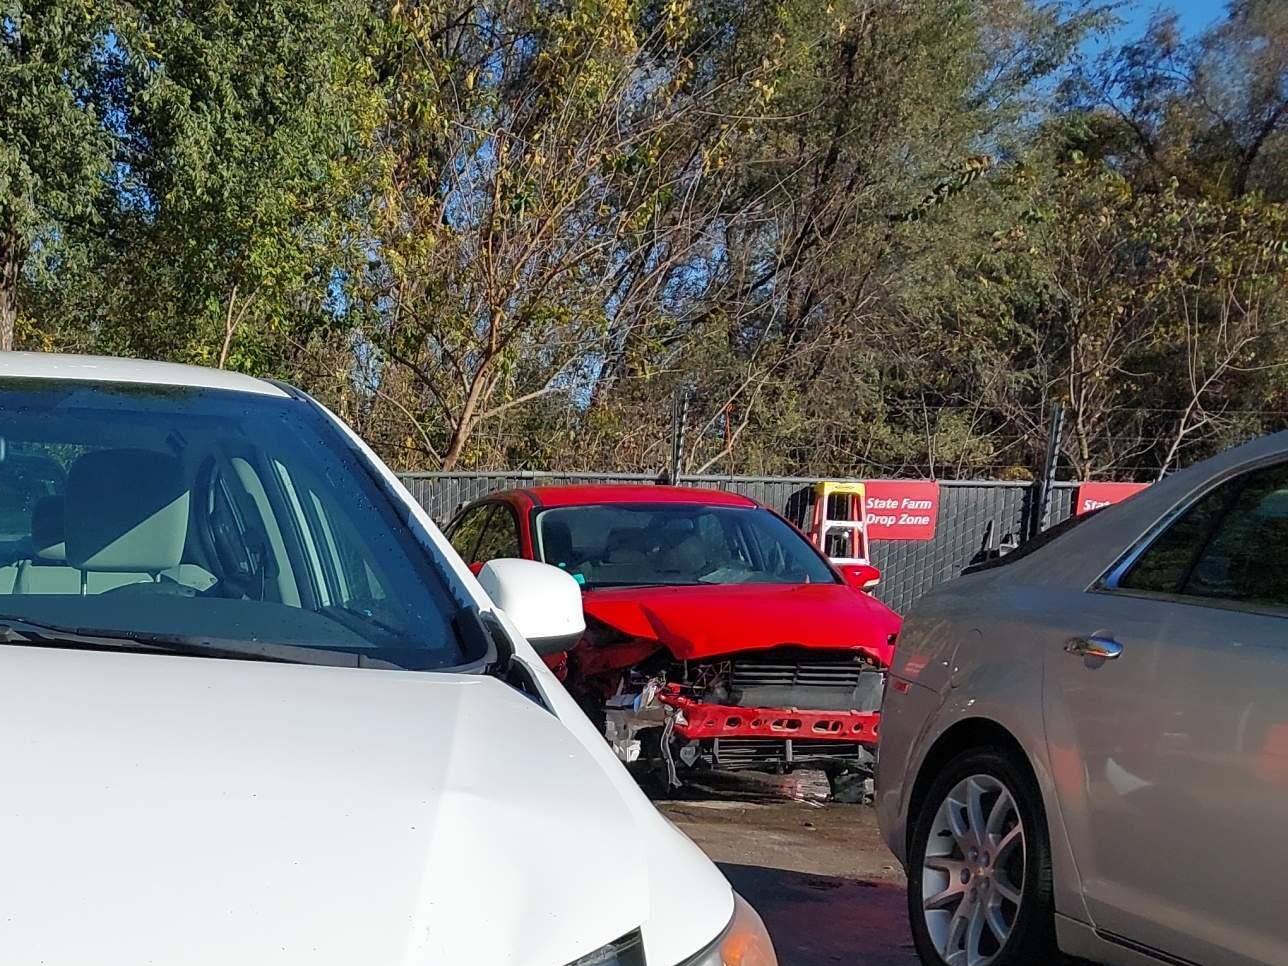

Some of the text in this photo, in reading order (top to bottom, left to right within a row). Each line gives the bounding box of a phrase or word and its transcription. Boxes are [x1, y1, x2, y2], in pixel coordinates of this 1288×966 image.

[866, 498, 932, 509] State Farm
[867, 513, 930, 527] Drop Zone
